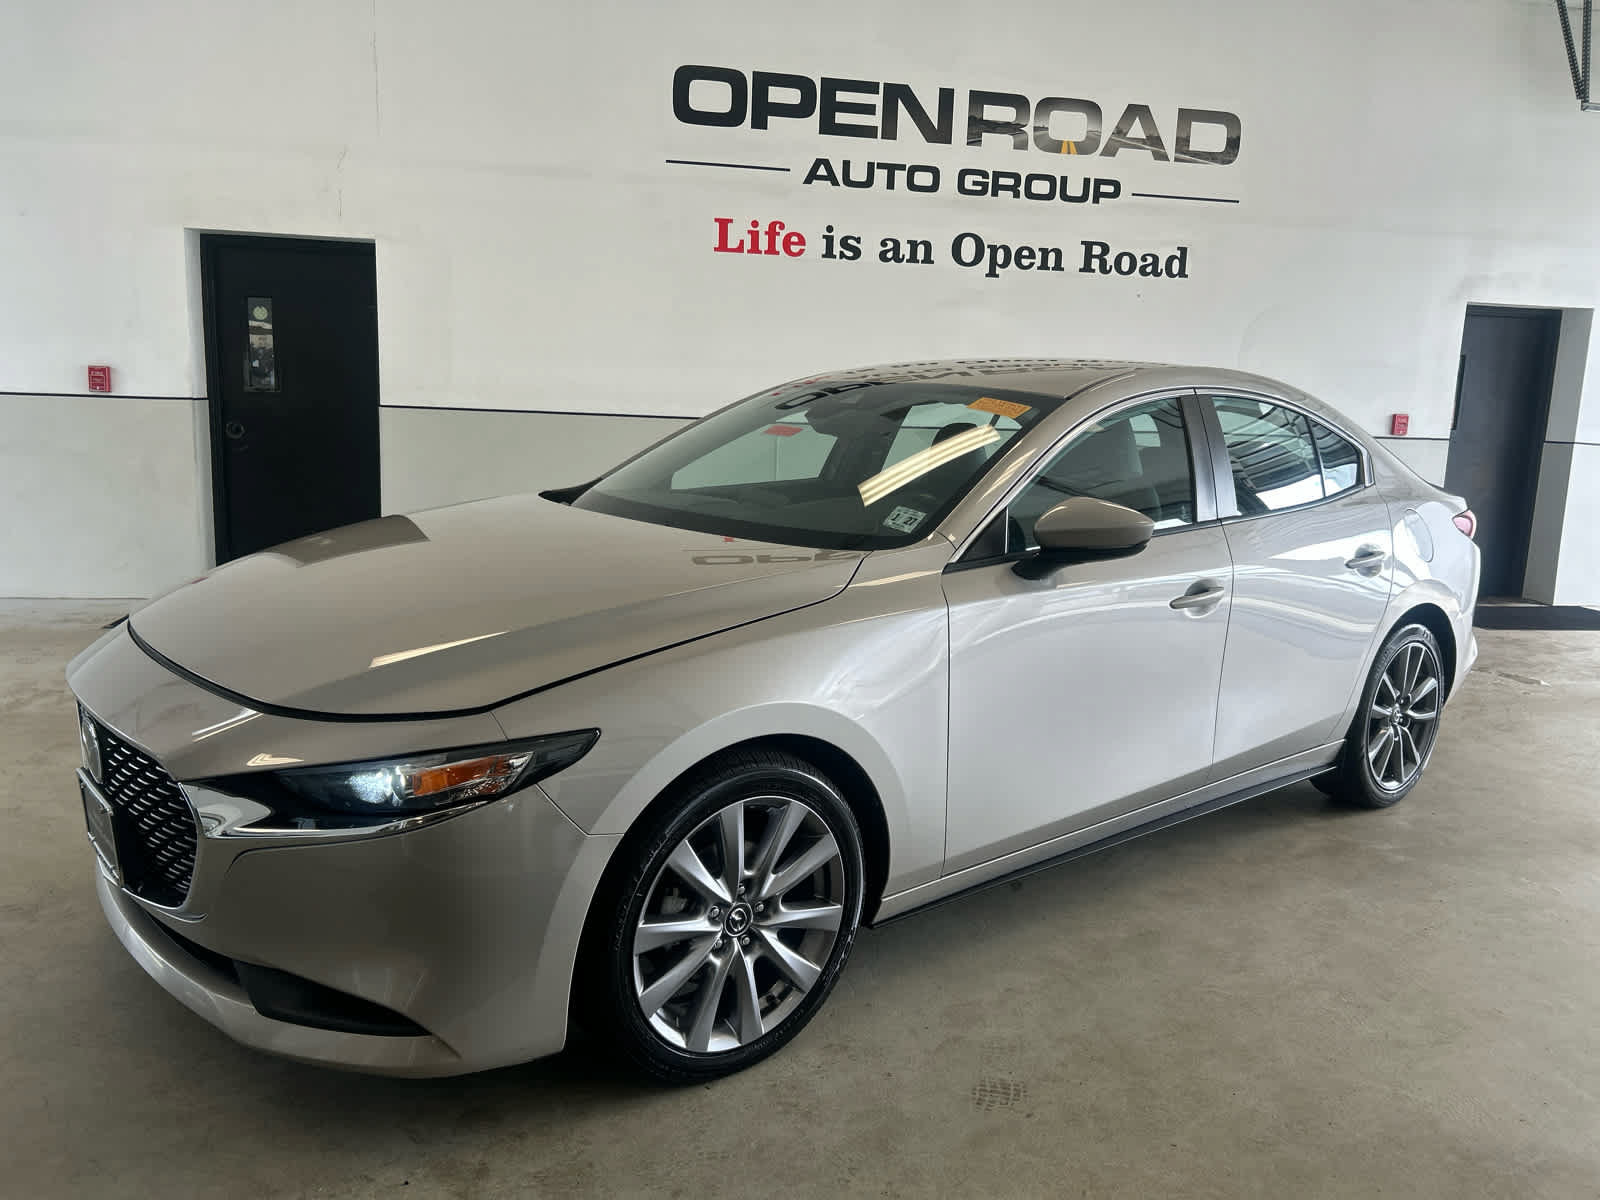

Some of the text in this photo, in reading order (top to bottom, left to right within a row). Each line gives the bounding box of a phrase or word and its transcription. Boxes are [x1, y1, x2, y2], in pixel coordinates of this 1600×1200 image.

[672, 64, 1242, 166] OPEN ROAD
[802, 157, 1122, 205] AUTO GROUP
[713, 217, 1189, 279] Life is an Open Road
